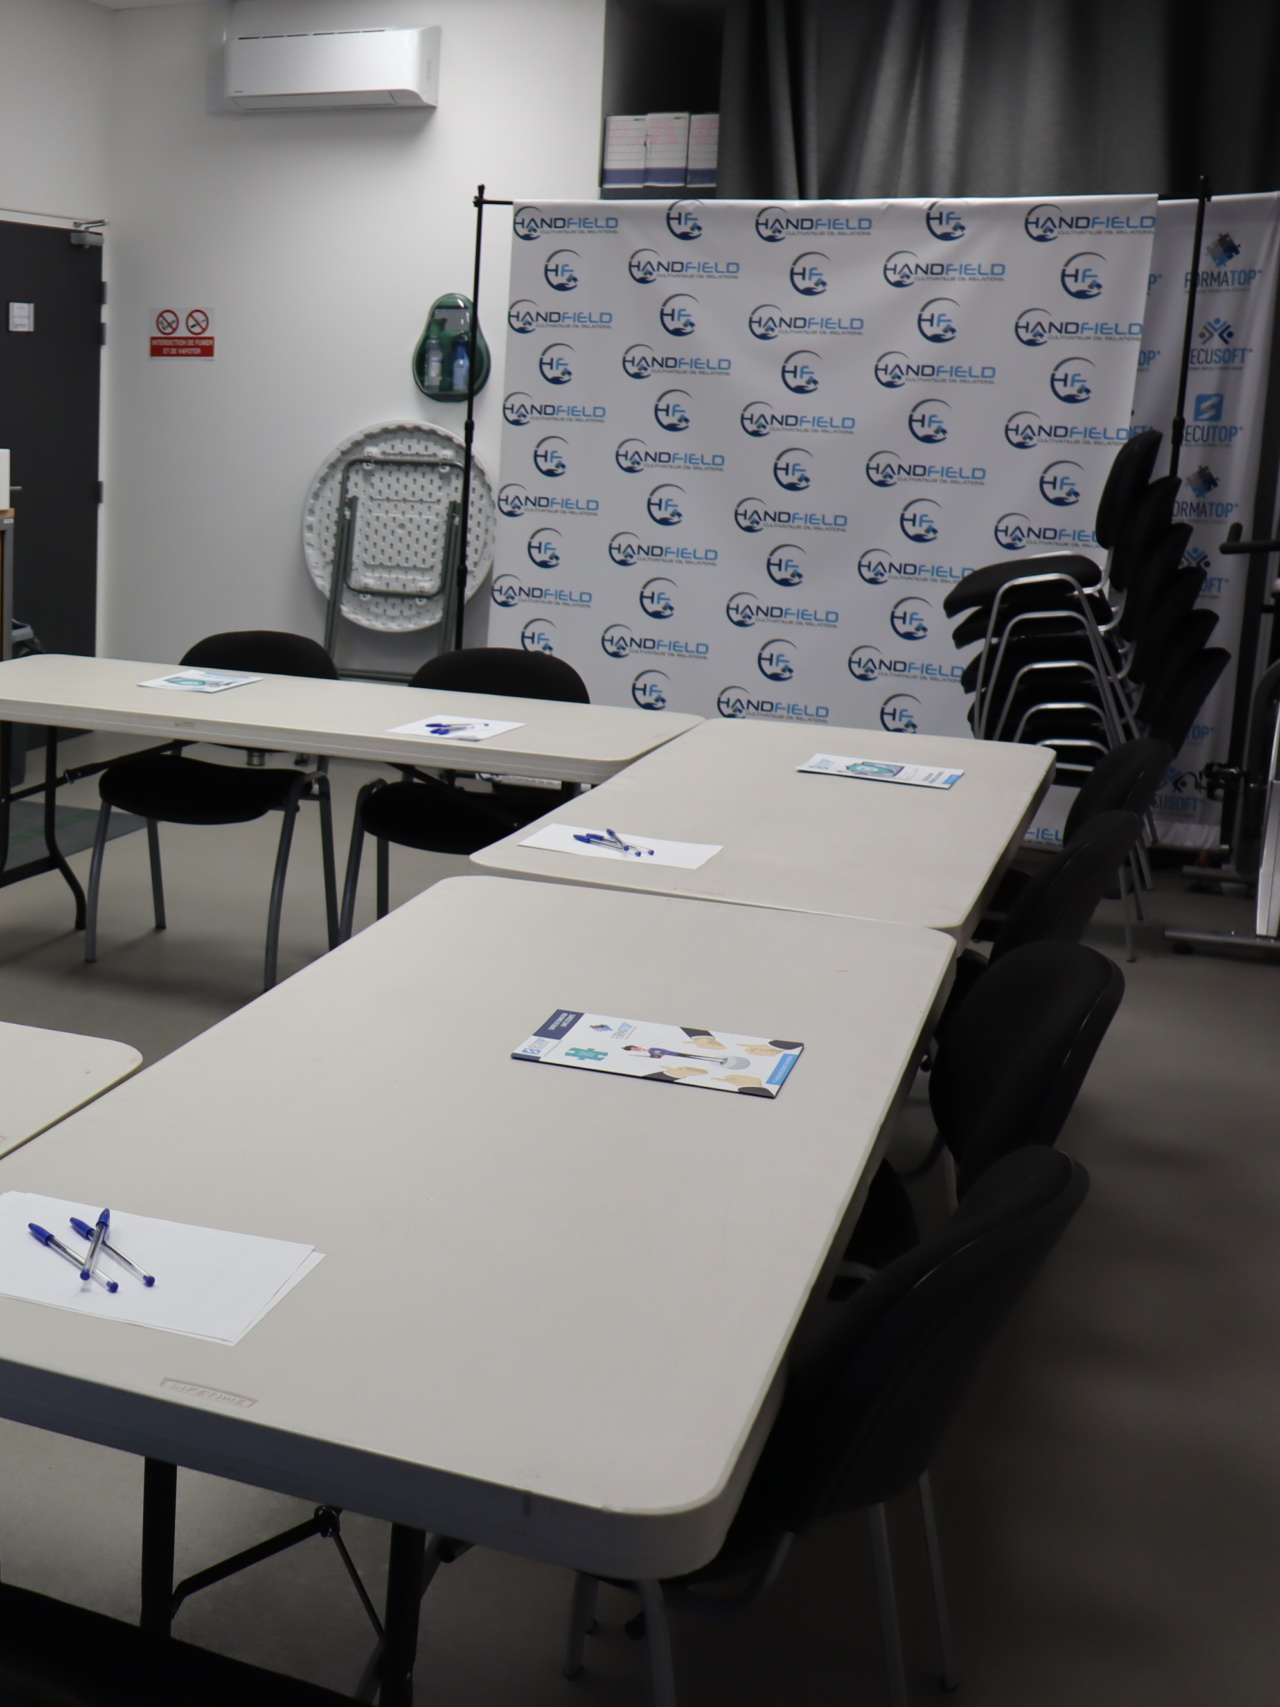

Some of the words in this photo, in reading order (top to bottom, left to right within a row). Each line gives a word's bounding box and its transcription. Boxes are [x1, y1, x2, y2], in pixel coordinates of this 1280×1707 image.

[513, 217, 618, 229] HANDFIELD
[755, 218, 872, 230] HANDFIELD
[1024, 216, 1155, 229] HANDFIELD
[628, 261, 739, 273] HANDFIELD
[883, 263, 1005, 275] HANDFIELD
[508, 311, 613, 323] HANDFIELD
[749, 317, 864, 330] HANDFIELD
[1015, 321, 1143, 335] HANDFIELD
[623, 356, 731, 370] HANDFIELD
[874, 364, 996, 378] HANDFIELD
[503, 403, 606, 417] HANDFIELD
[741, 413, 855, 429] HANDFIELD
[1005, 424, 1131, 440] HANDFIELD
[616, 450, 725, 466] HANDFIELD
[866, 463, 986, 480] HANDFIELD
[498, 494, 600, 511] HANDFIELD
[734, 509, 847, 527] HANDFIELD
[994, 525, 1097, 542] HANDFIEL
[609, 543, 718, 561] HANDFIELD
[492, 584, 593, 603] HANDFIELD
[726, 603, 839, 623] HANDFIELD
[602, 635, 709, 654] HANDFIELD
[717, 697, 829, 718] HANDFIELD
